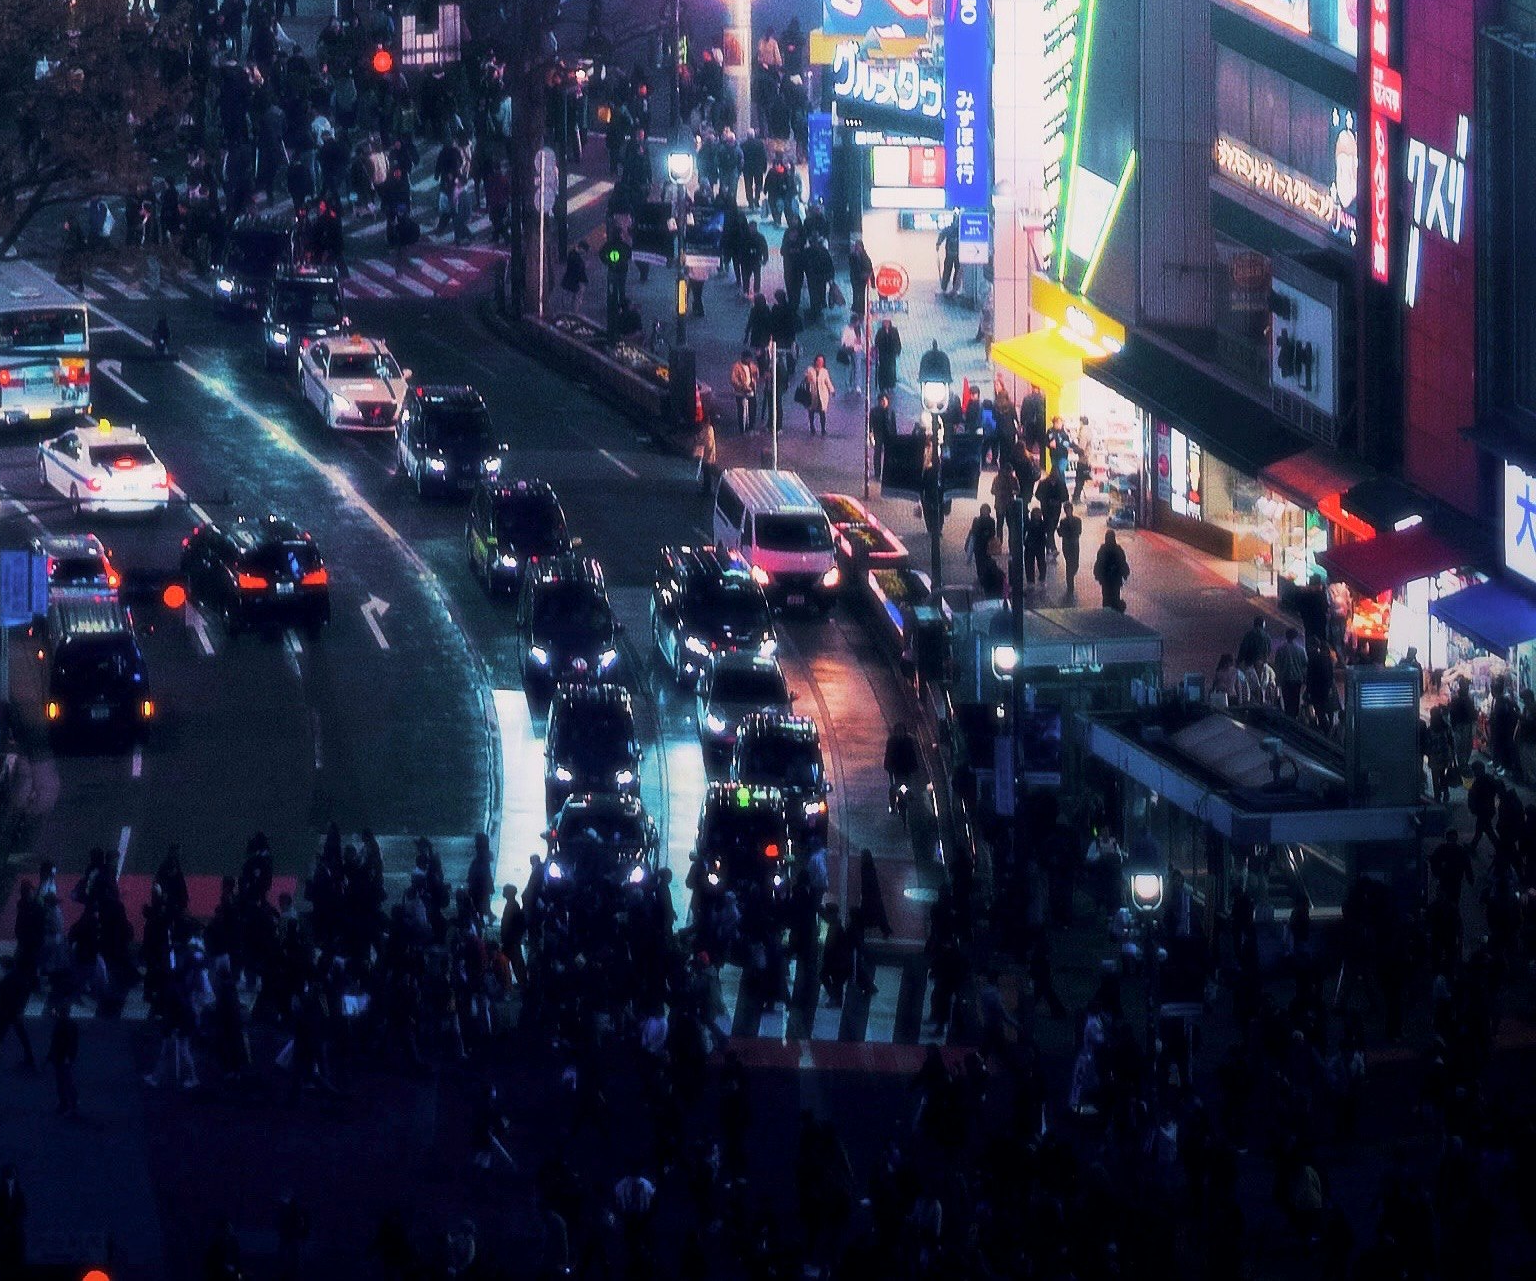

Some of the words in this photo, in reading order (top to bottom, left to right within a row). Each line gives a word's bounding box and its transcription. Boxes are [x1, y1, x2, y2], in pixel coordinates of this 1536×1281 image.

[833, 40, 945, 120] グルメタウ
